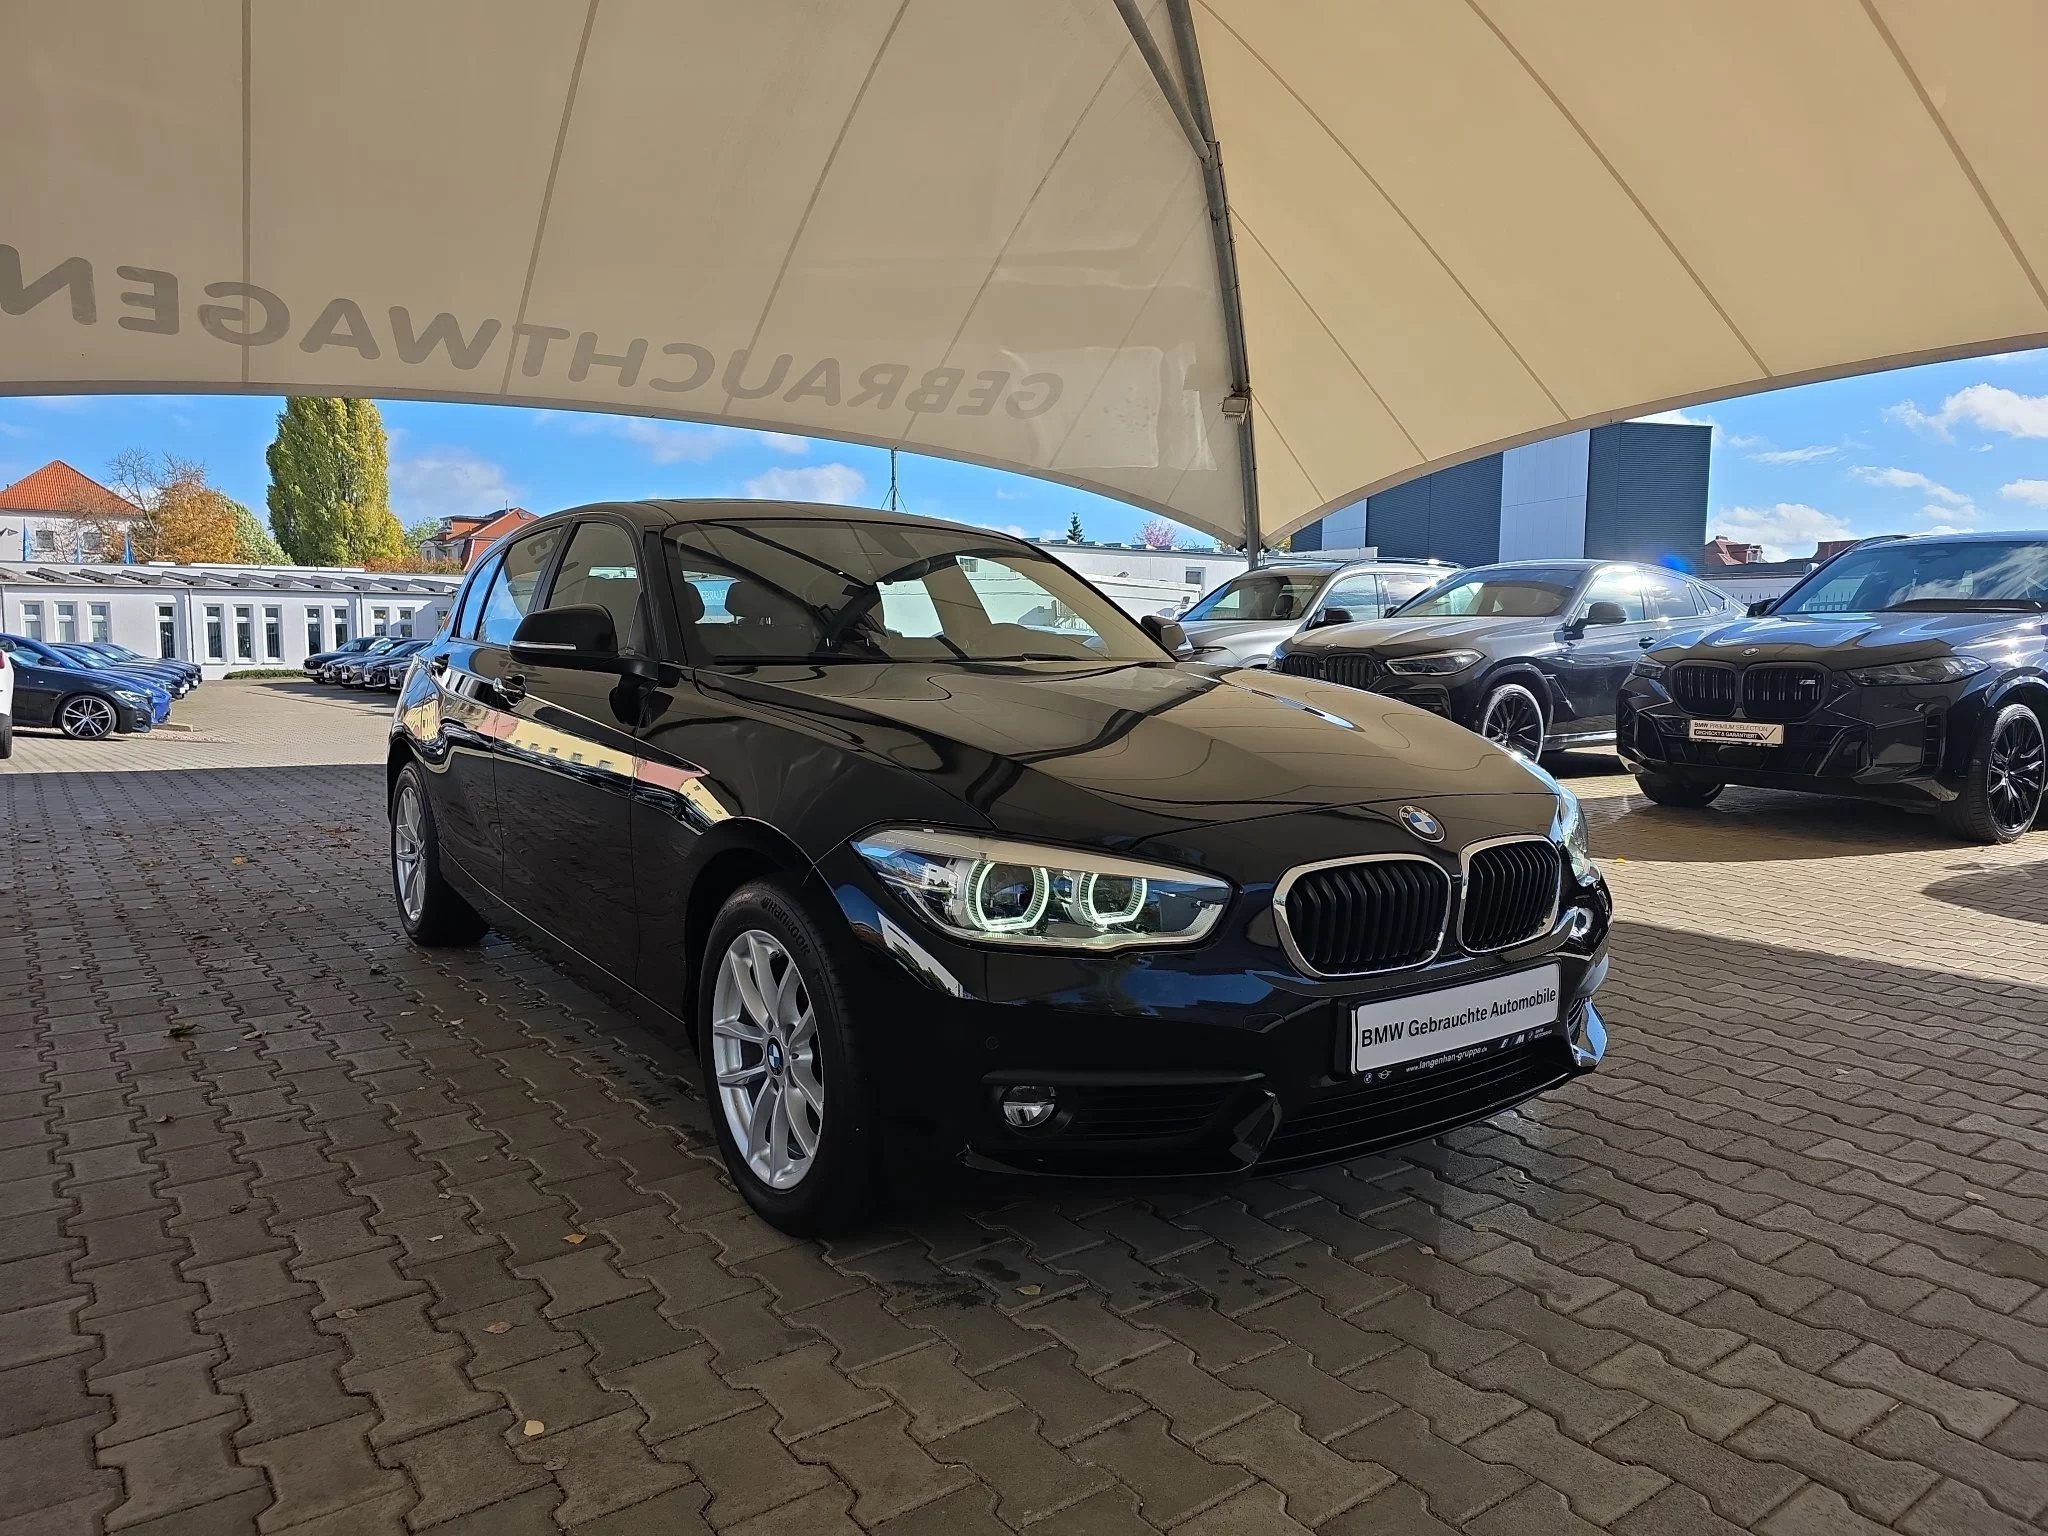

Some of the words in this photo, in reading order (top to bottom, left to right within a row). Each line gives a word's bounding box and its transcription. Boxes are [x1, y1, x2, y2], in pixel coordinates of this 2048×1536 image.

[1361, 1022, 1404, 1047] BMW
[1408, 1008, 1487, 1037] Gebrauchte
[1490, 988, 1556, 1017] Automobile
[1406, 1047, 1488, 1072] www.langenhan-gruppe.de
